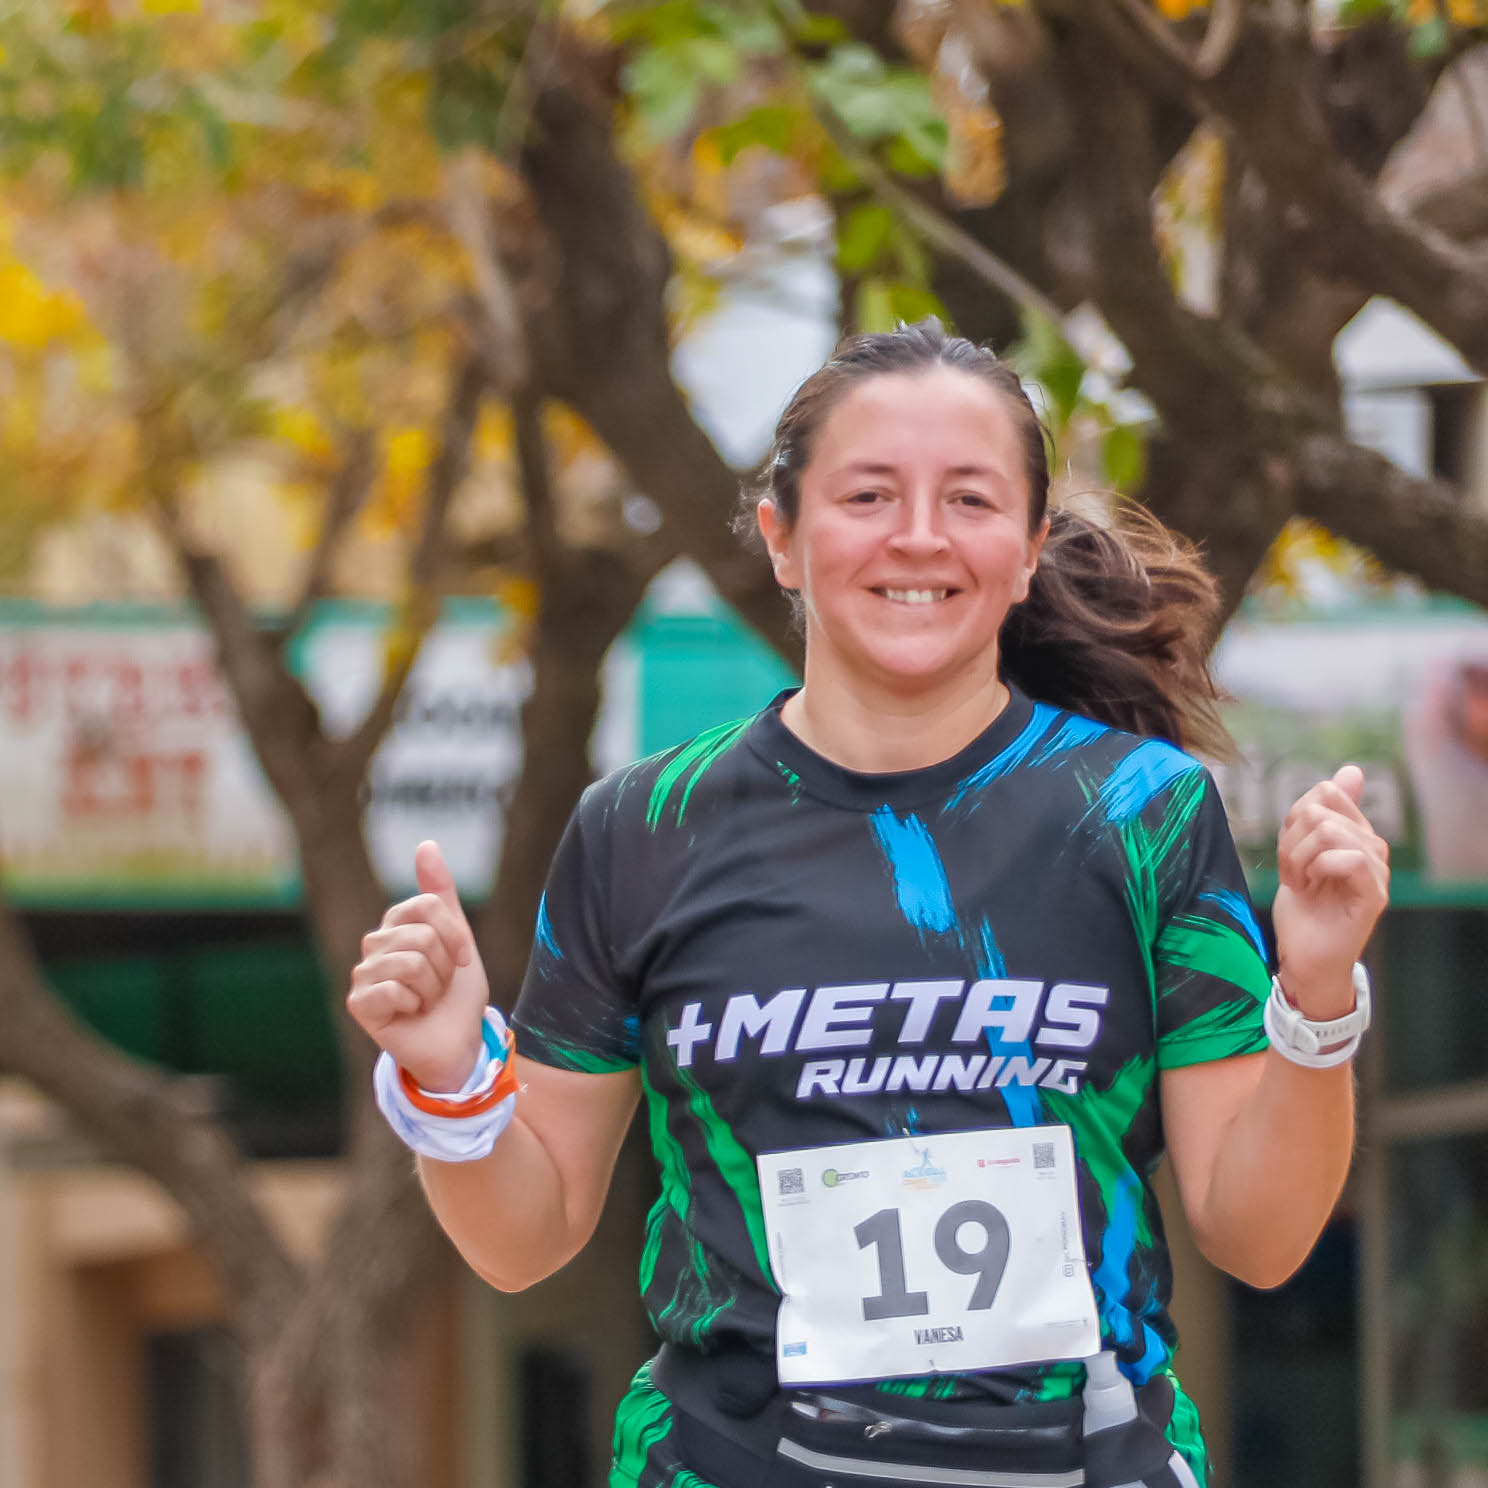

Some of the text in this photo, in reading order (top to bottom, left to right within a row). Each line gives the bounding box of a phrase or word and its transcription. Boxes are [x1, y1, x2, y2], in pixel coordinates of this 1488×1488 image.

[667, 979, 1109, 1067] +METAS
[796, 1055, 1088, 1097] RUNNING
[853, 1200, 1011, 1321] 19
[914, 1326, 964, 1344] VANESA
